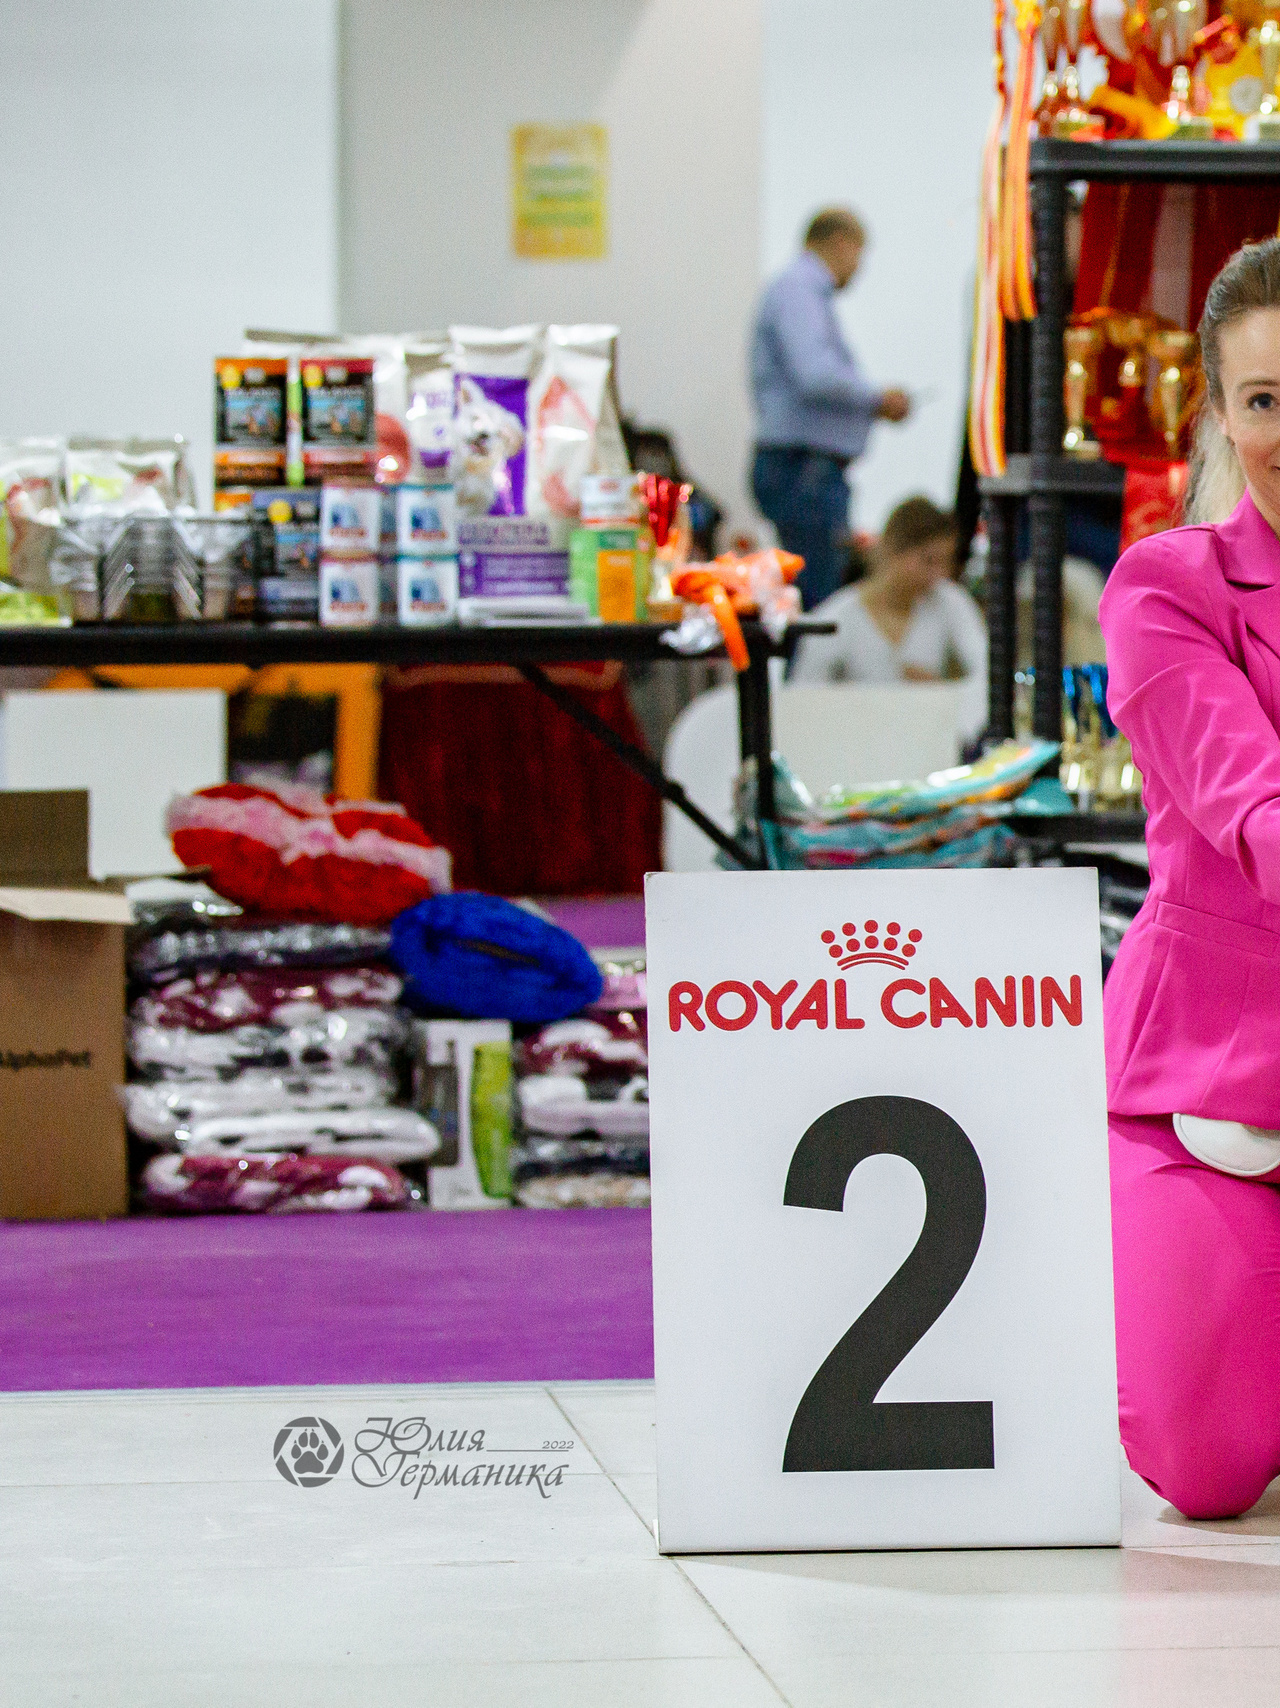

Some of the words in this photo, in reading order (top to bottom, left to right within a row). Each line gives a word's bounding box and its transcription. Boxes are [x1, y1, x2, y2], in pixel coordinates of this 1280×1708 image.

[668, 977, 866, 1033] ROYAL
[880, 974, 1083, 1030] CANIN
[782, 1095, 995, 1473] 2
